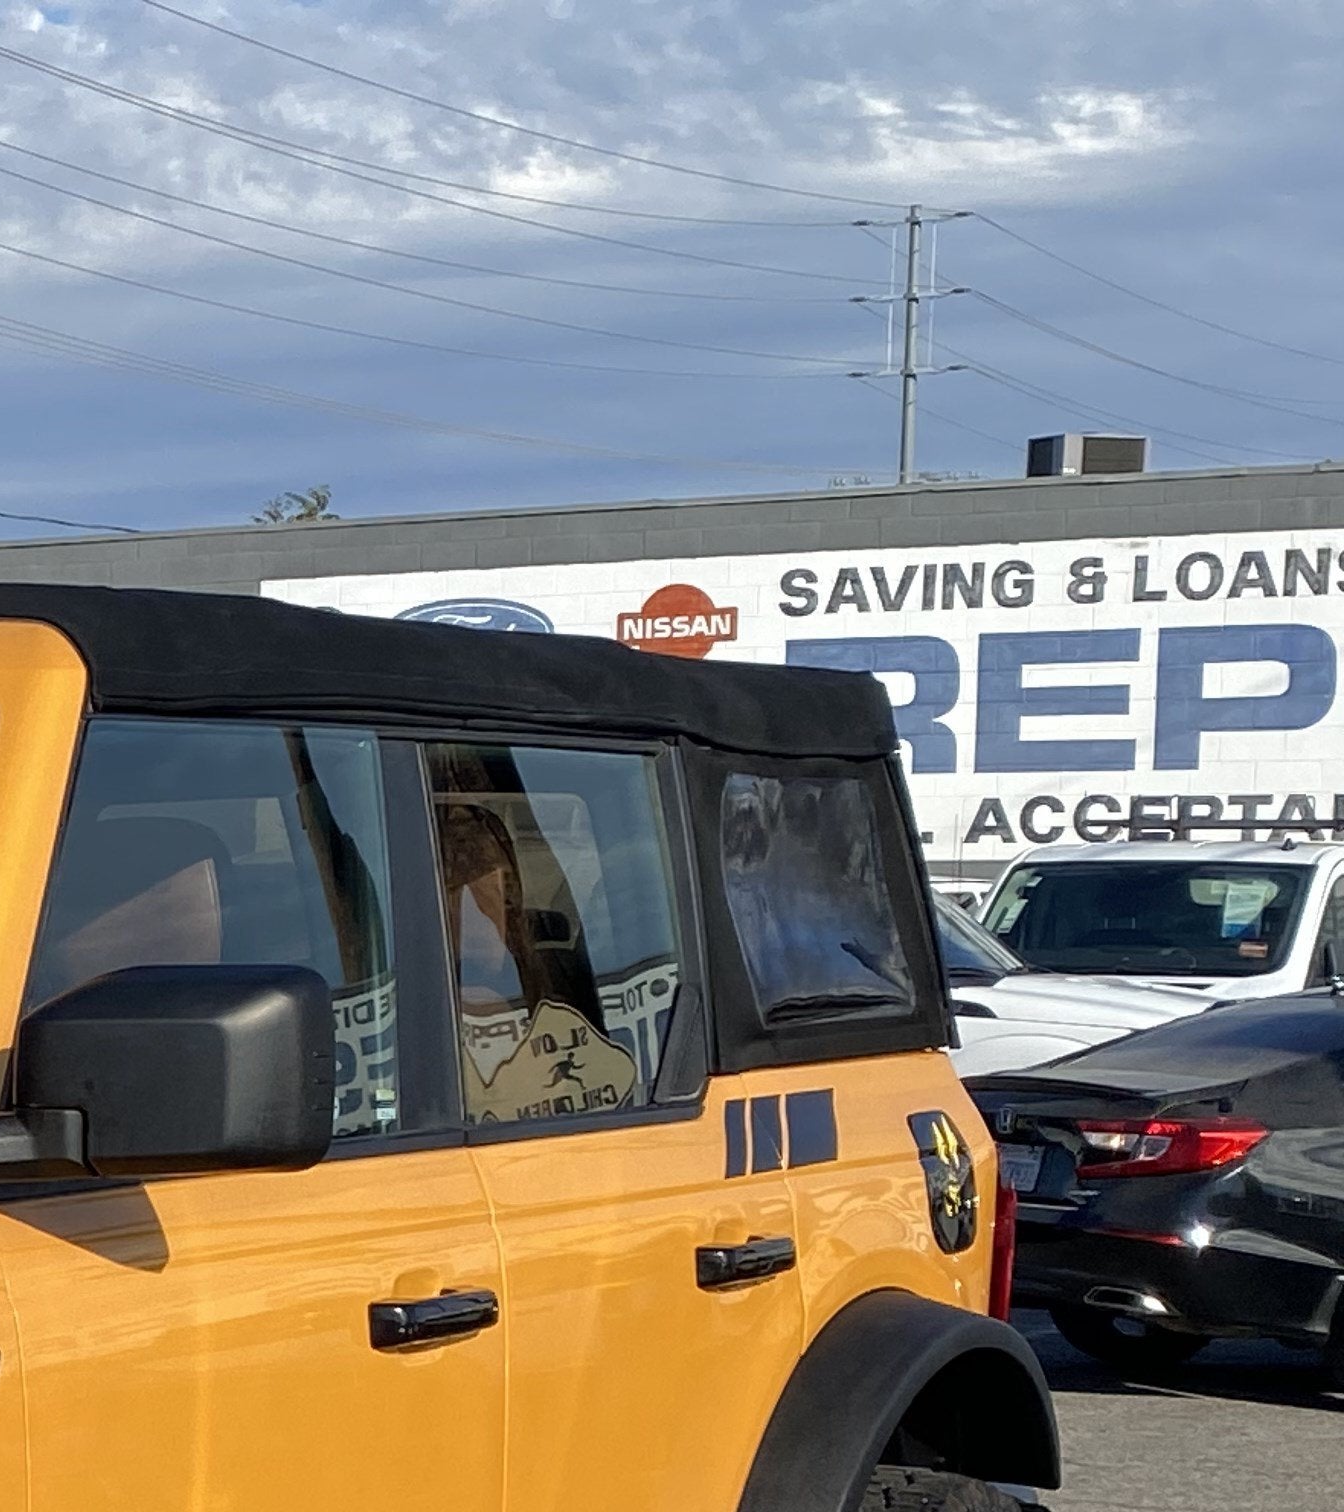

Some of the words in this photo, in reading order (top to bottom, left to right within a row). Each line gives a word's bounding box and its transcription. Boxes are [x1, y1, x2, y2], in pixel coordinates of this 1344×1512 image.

[779, 558, 1035, 618] SAVING
[1067, 557, 1109, 605] &
[1132, 547, 1344, 604] LOAN
[623, 612, 732, 642] NISSAN
[962, 793, 1344, 844] ACCEPTA
